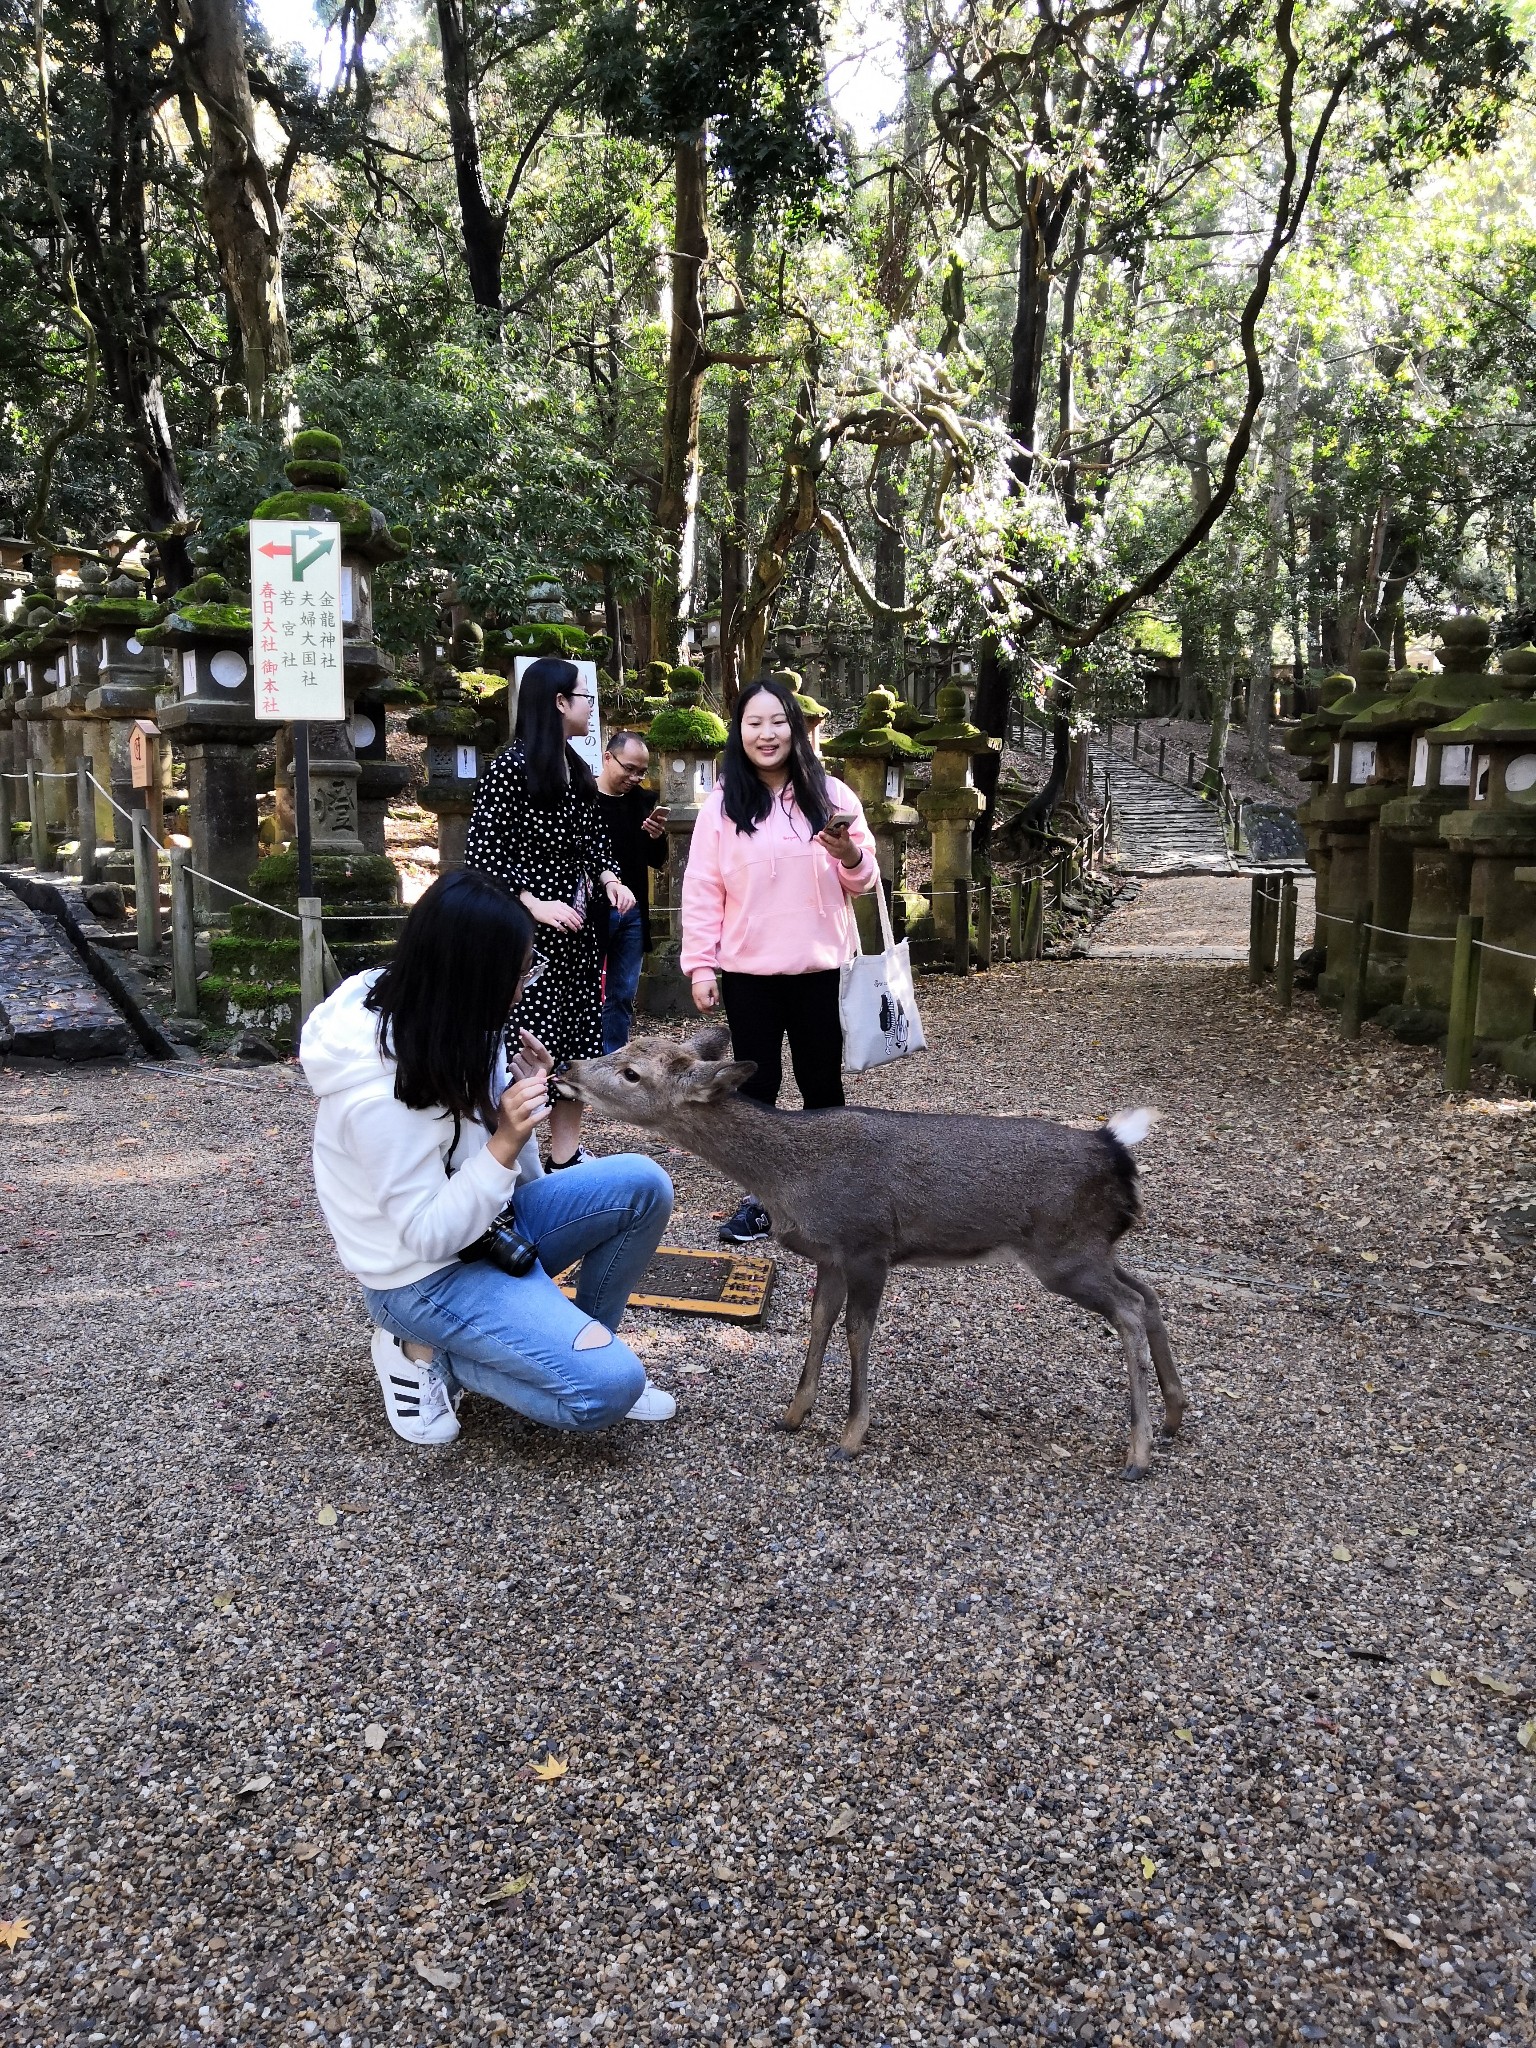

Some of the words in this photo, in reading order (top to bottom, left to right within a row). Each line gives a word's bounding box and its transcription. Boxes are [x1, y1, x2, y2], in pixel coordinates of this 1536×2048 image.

[279, 589, 298, 667] 若宮社
[299, 590, 318, 687] 夫婦大国社
[318, 590, 337, 668] 金龍神社
